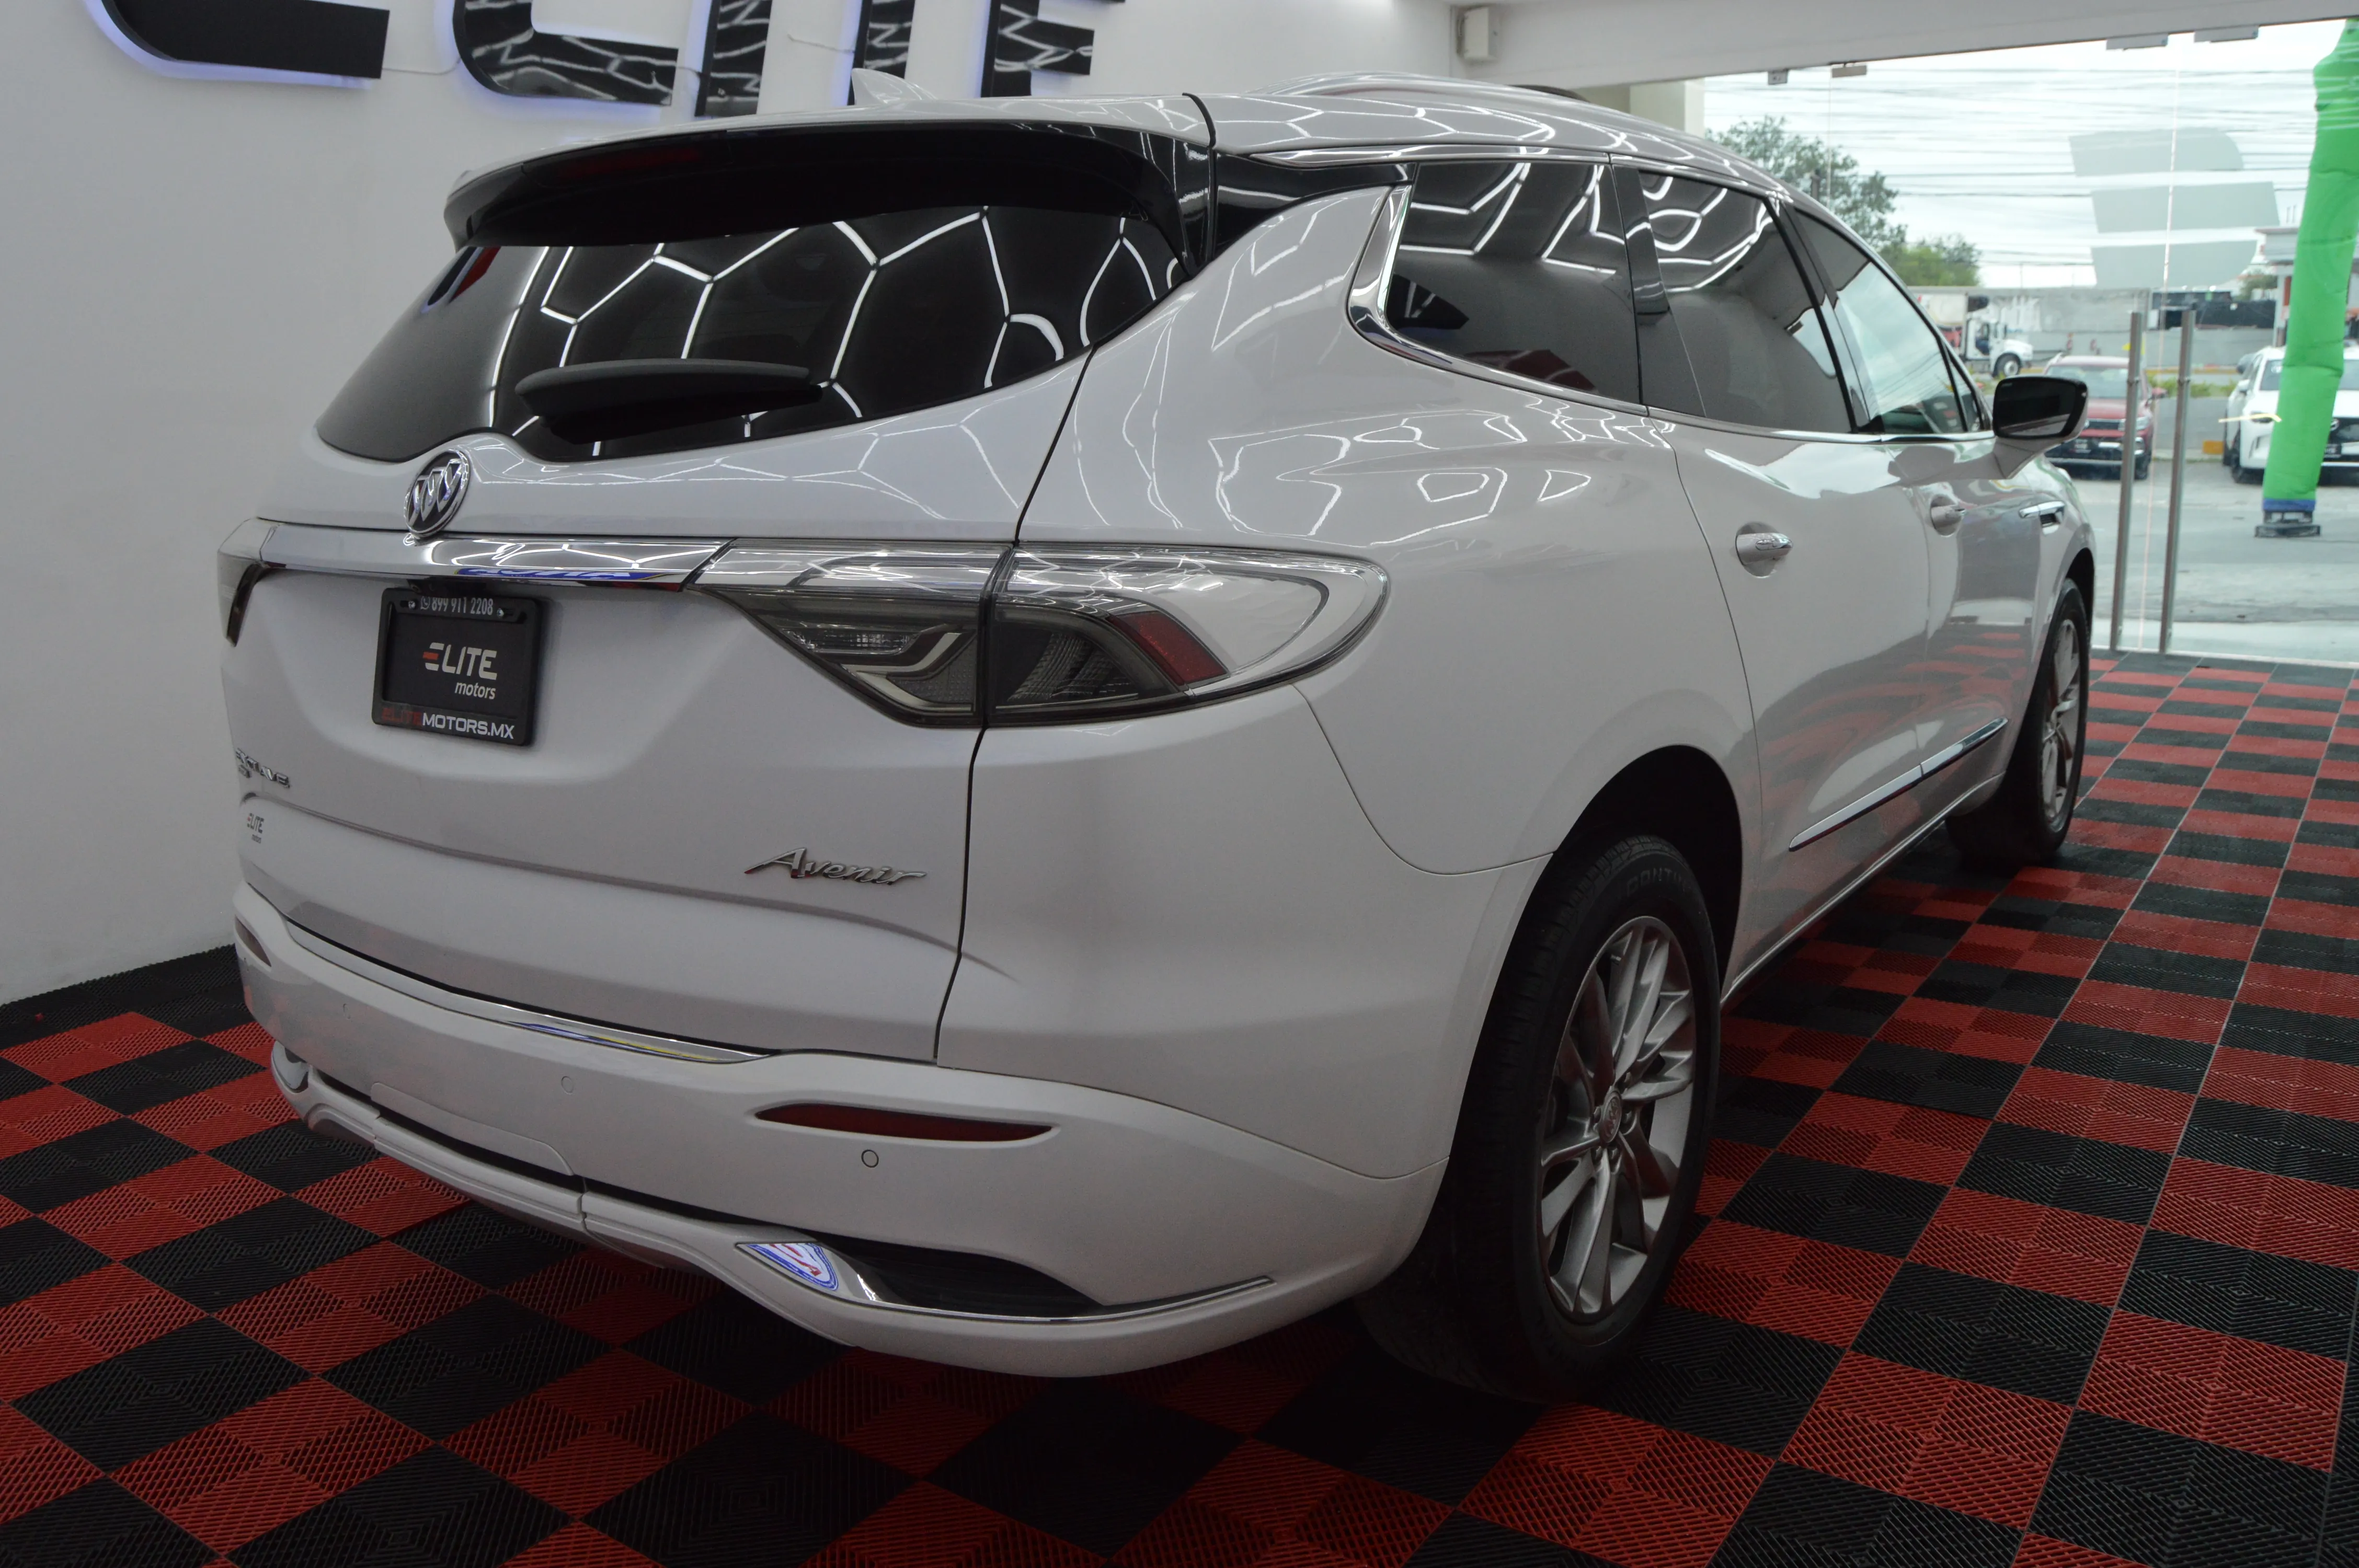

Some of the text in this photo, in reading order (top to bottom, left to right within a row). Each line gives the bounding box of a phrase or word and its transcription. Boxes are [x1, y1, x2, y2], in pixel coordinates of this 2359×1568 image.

[431, 597, 494, 615] 899 911 2208
[422, 642, 497, 681] ELITE
[454, 682, 496, 699] motors
[743, 847, 927, 885] Avenir
